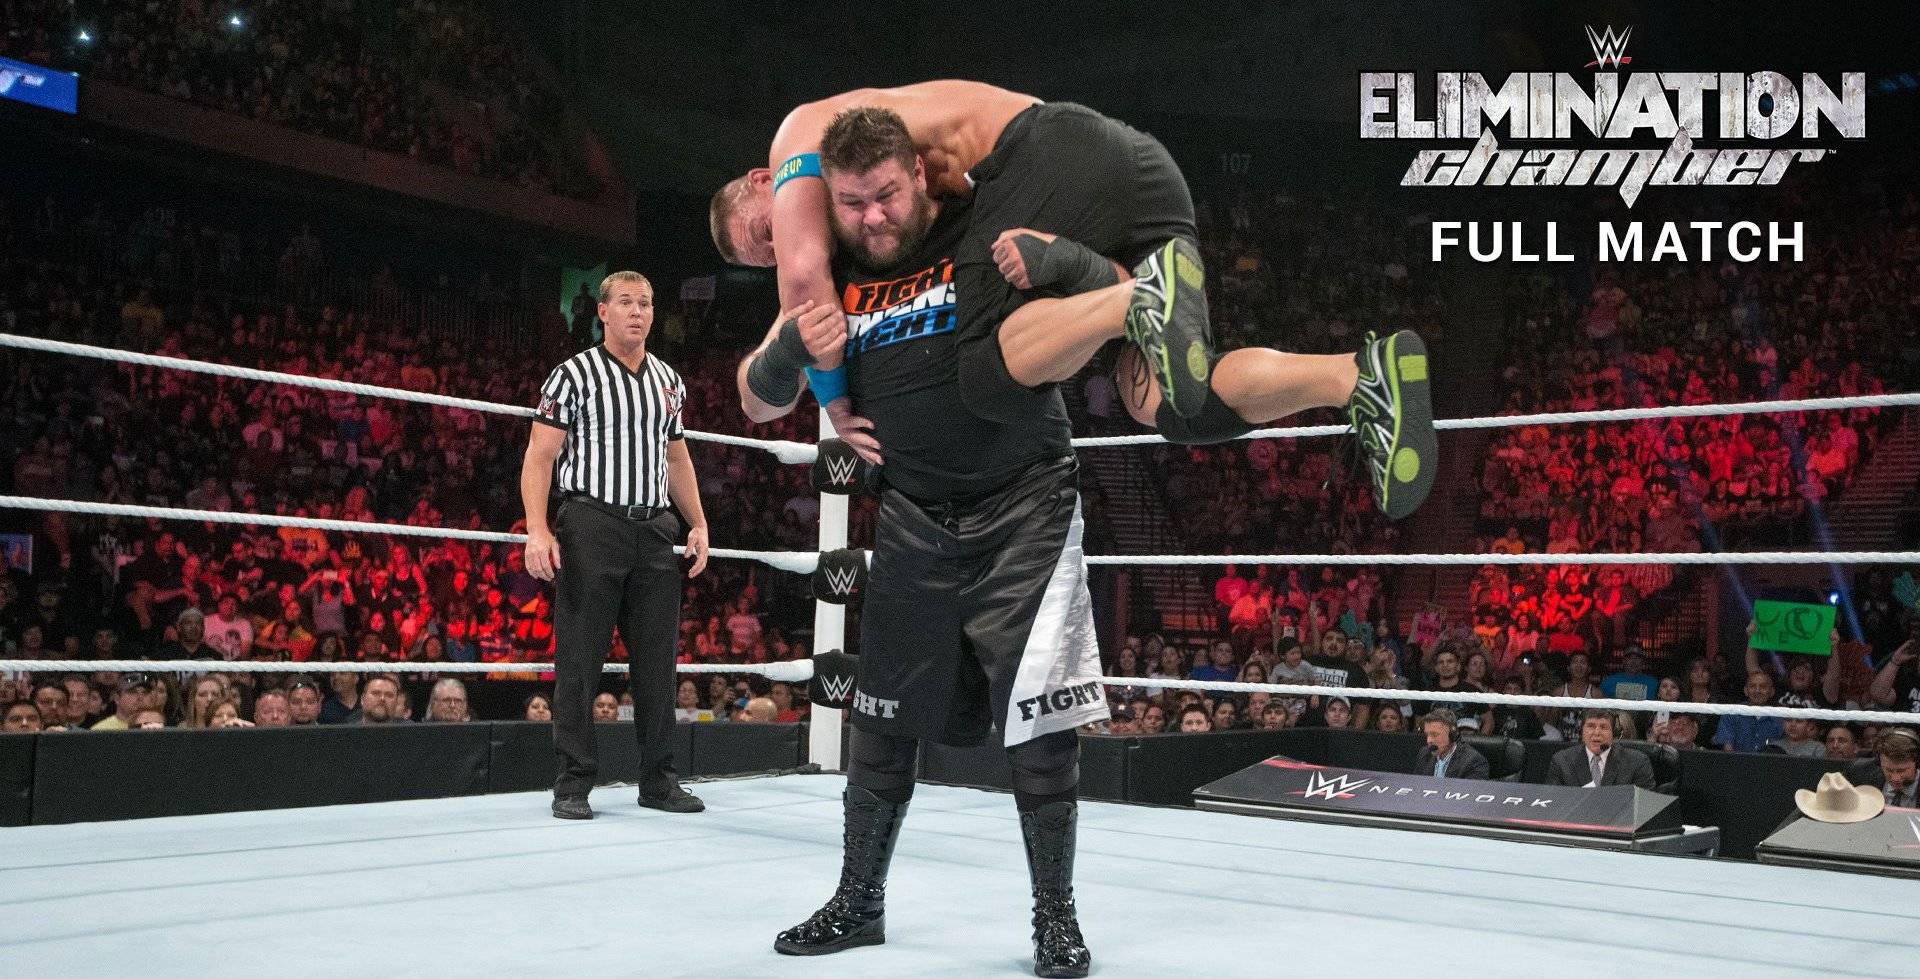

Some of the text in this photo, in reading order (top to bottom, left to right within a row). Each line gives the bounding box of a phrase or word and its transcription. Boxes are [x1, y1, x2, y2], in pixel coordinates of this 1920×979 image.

[1220, 153, 1252, 174] 107
[1016, 681, 1102, 721] FIGHT
[1368, 785, 1553, 808] NETWORK
